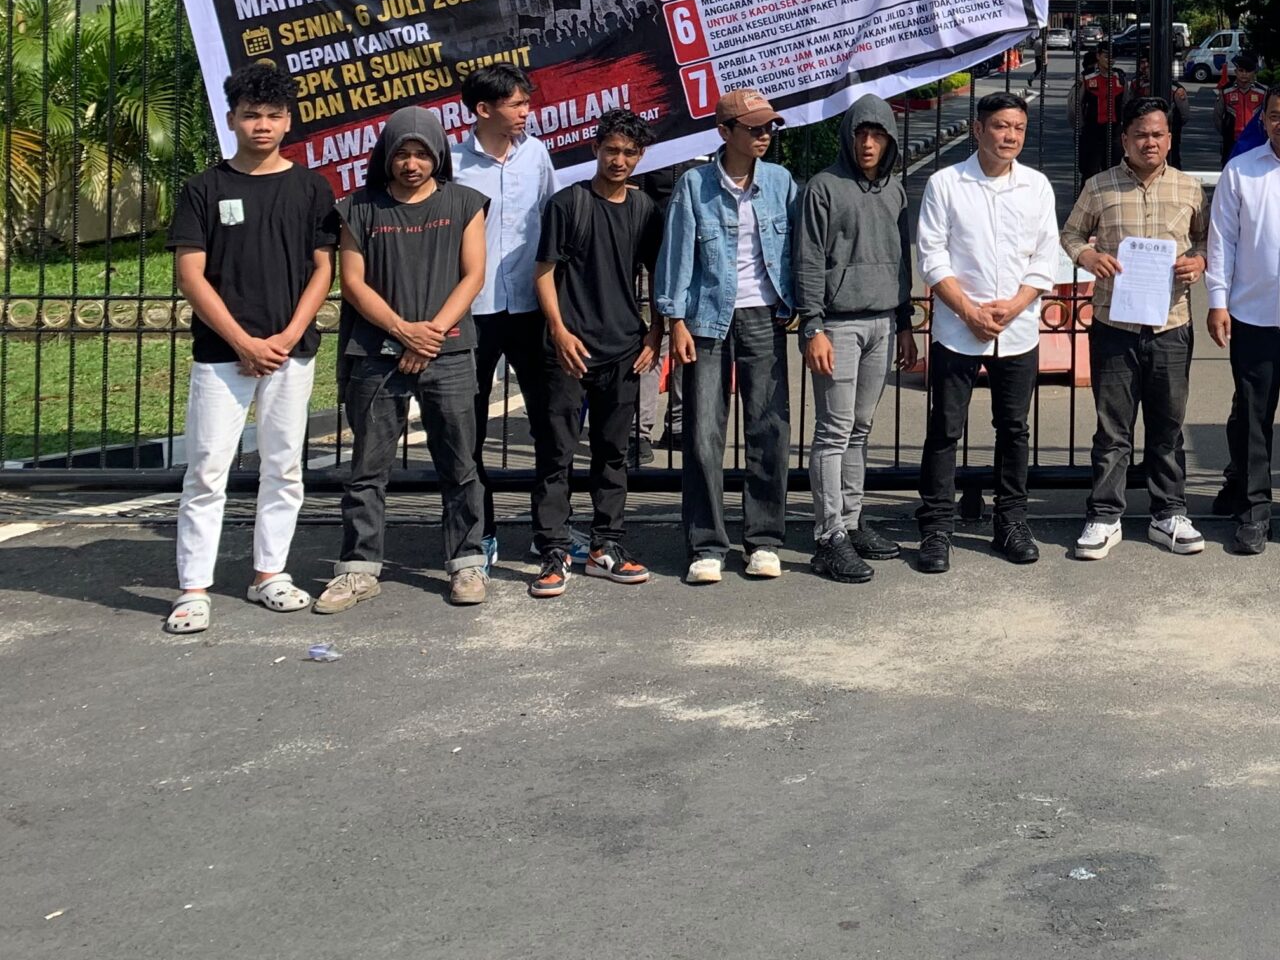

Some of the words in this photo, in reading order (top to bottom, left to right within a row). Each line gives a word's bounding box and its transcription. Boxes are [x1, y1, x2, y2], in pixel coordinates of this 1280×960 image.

[278, 10, 353, 45] SENIN,
[355, 4, 370, 26] 6
[673, 7, 696, 44] 6
[712, 27, 777, 51] LABUHANBATU
[778, 16, 820, 33] SELATAN.
[286, 41, 350, 73] DEPAN
[353, 22, 431, 56] KANTOR
[344, 61, 366, 85] RI
[370, 41, 443, 78] SUMUT
[718, 53, 756, 71] APABILA
[757, 39, 805, 59] TUNTUTAN
[806, 33, 830, 47] KAMI
[833, 26, 855, 40] ATAU
[298, 92, 345, 123] DAN
[348, 67, 453, 110] KEJATISU
[688, 69, 707, 108] 7
[724, 78, 754, 93] DEPAN
[756, 67, 795, 84] GEDUNG
[796, 61, 816, 73] KPK
[818, 58, 828, 67] RI
[305, 121, 387, 169] LAWA
[557, 132, 580, 147] DAN
